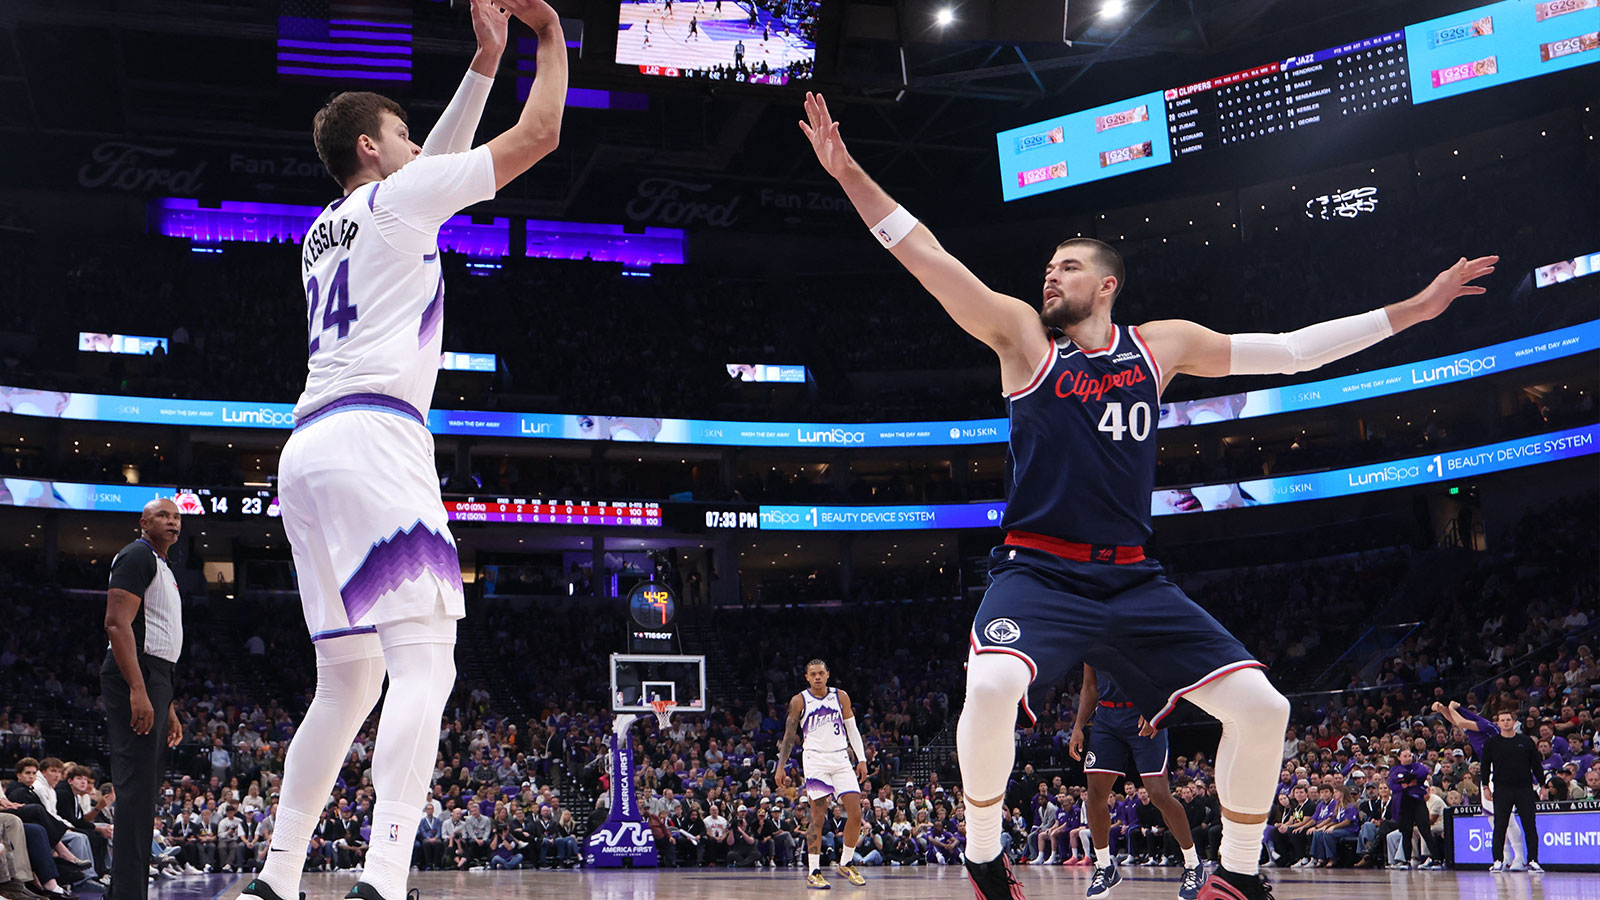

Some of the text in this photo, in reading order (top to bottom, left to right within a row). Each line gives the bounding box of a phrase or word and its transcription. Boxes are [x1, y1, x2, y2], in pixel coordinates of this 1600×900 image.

[1550, 0, 1575, 11] G2G
[1440, 26, 1465, 39] G2G
[1554, 38, 1580, 51] G2G
[1296, 54, 1314, 66] JAZZ
[646, 66, 660, 74] LAC
[768, 75, 782, 85] UTA
[1444, 65, 1469, 78] G2G
[1179, 80, 1212, 96] CLIPPERS
[1106, 114, 1126, 124] G2G
[1023, 136, 1042, 146] G2G
[1110, 148, 1130, 159] G2G
[78, 142, 327, 194] Ford Fan Zon
[1027, 169, 1047, 180] G2G
[625, 178, 742, 228] Ford
[760, 188, 801, 209] Fan
[304, 219, 358, 272] KESSLER
[307, 257, 358, 357] 24
[1515, 336, 1580, 357] WASH THE DAY AWAY
[1055, 364, 1146, 402] Clippers
[1298, 391, 1321, 401] SKIN
[1342, 385, 1360, 393] WASH
[1385, 376, 1402, 385] AWAY
[1412, 356, 1496, 384] LumiSpa
[222, 408, 294, 426] LumiSpa
[1098, 402, 1150, 441] 40
[798, 429, 864, 445] LumiSpa
[962, 429, 976, 437] NU
[977, 428, 997, 436] SKIN
[1289, 482, 1312, 493] SKIN
[1349, 466, 1419, 486] LumiSpa
[1426, 455, 1443, 477] #1
[1448, 452, 1494, 470] BEAUTY
[1497, 443, 1541, 461] DEVICE
[1544, 433, 1592, 452] SYSTEM
[99, 493, 121, 503] SKIN
[210, 497, 262, 514] 14 23
[456, 503, 470, 511] 0/0
[566, 506, 572, 514] 0
[822, 512, 858, 522] BEAUTY
[860, 512, 896, 522] DEVICE
[898, 512, 935, 522] SYSTEM
[705, 511, 758, 529] 07:33 PM
[643, 591, 669, 604] 4:42
[653, 603, 666, 624] 7
[808, 712, 840, 732] UTAH
[834, 723, 840, 735] 3
[620, 751, 630, 816] AMERICA FIRST
[1460, 806, 1481, 814] DELTA
[1469, 828, 1481, 852] 5
[1543, 832, 1572, 846] ONE
